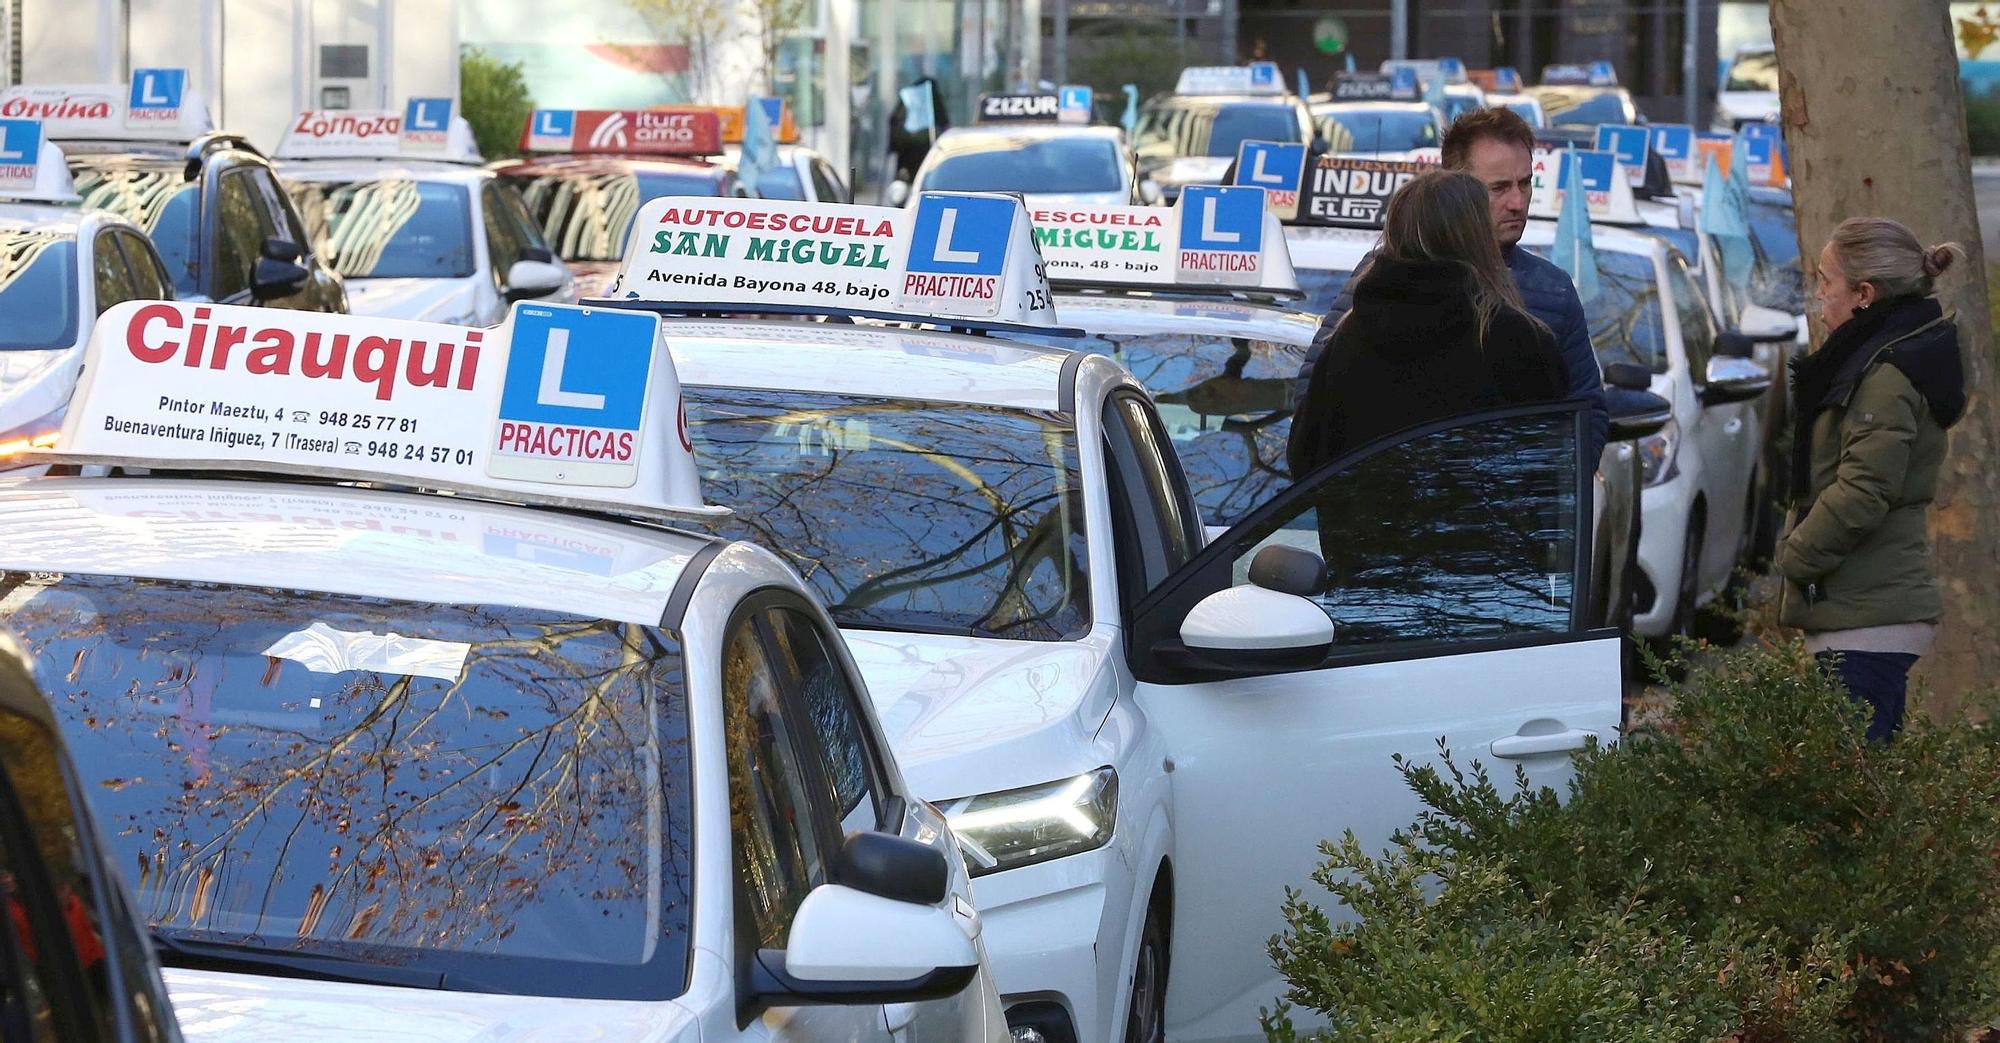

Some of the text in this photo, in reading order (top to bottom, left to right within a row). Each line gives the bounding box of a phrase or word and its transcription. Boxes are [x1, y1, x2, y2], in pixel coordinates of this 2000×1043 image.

[142, 74, 168, 103] L
[2, 96, 109, 118] Orvina
[129, 108, 177, 120] PRACTICAS
[415, 103, 437, 128] L
[636, 112, 695, 128] iturr
[985, 96, 1058, 115] ZIZUR
[1252, 149, 1283, 183] L
[660, 208, 894, 238] AUTOESCUELA
[1027, 211, 1162, 227] ESCUELA
[1201, 196, 1240, 243] L
[650, 230, 731, 258] SAN
[933, 207, 980, 264] L
[1090, 260, 1109, 269] 48
[1125, 262, 1158, 272] bajo
[1181, 252, 1257, 272] PRACTICAS
[647, 269, 890, 300] Avenida Bayona 48, bajo
[904, 274, 995, 299] PRACTICAS
[126, 304, 484, 402] Cirauqui
[537, 327, 605, 410] L
[158, 396, 418, 433] Pintor Maeztu, 4 948 25 77 81
[104, 415, 474, 466] Buenaventura Iñiguez, 7 (Trasera) 948 24 57 01
[499, 422, 633, 461] PRACTICAS
